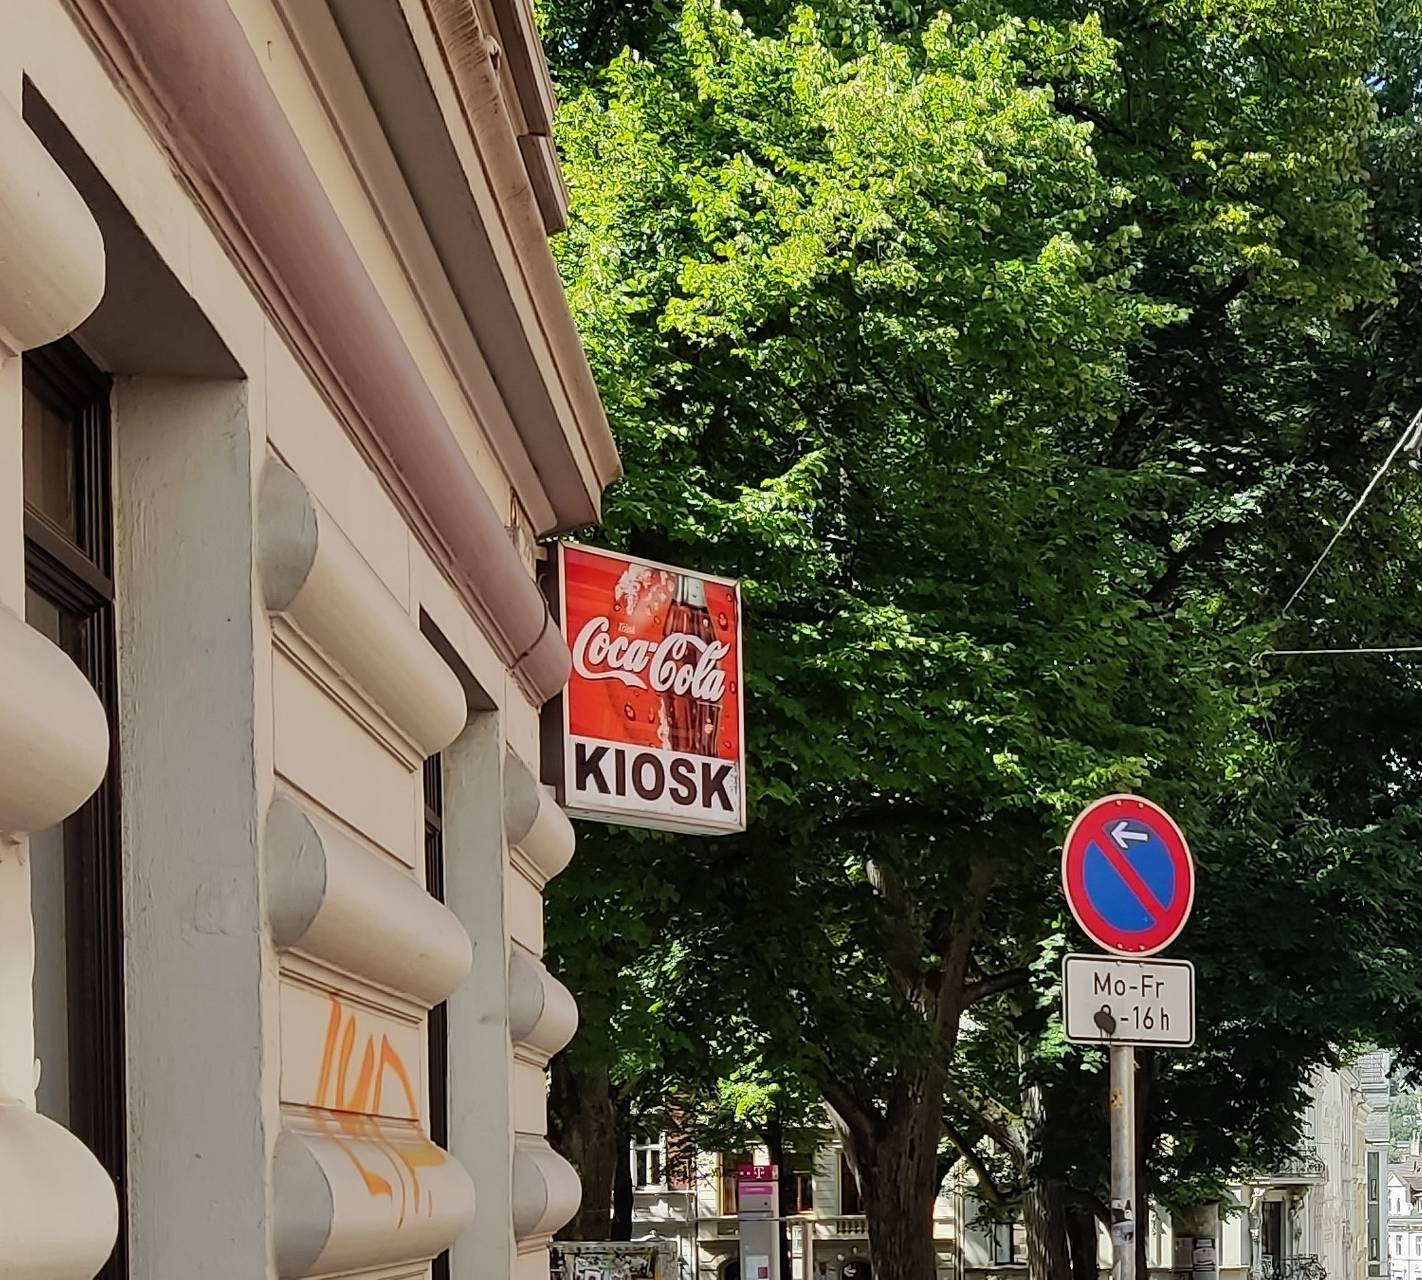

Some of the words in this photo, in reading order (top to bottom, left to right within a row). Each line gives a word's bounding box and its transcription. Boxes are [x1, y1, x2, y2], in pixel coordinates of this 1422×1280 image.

[572, 616, 731, 701] Coca-Cola
[574, 742, 735, 812] KIOSK
[1094, 971, 1165, 999] Mo-Fr
